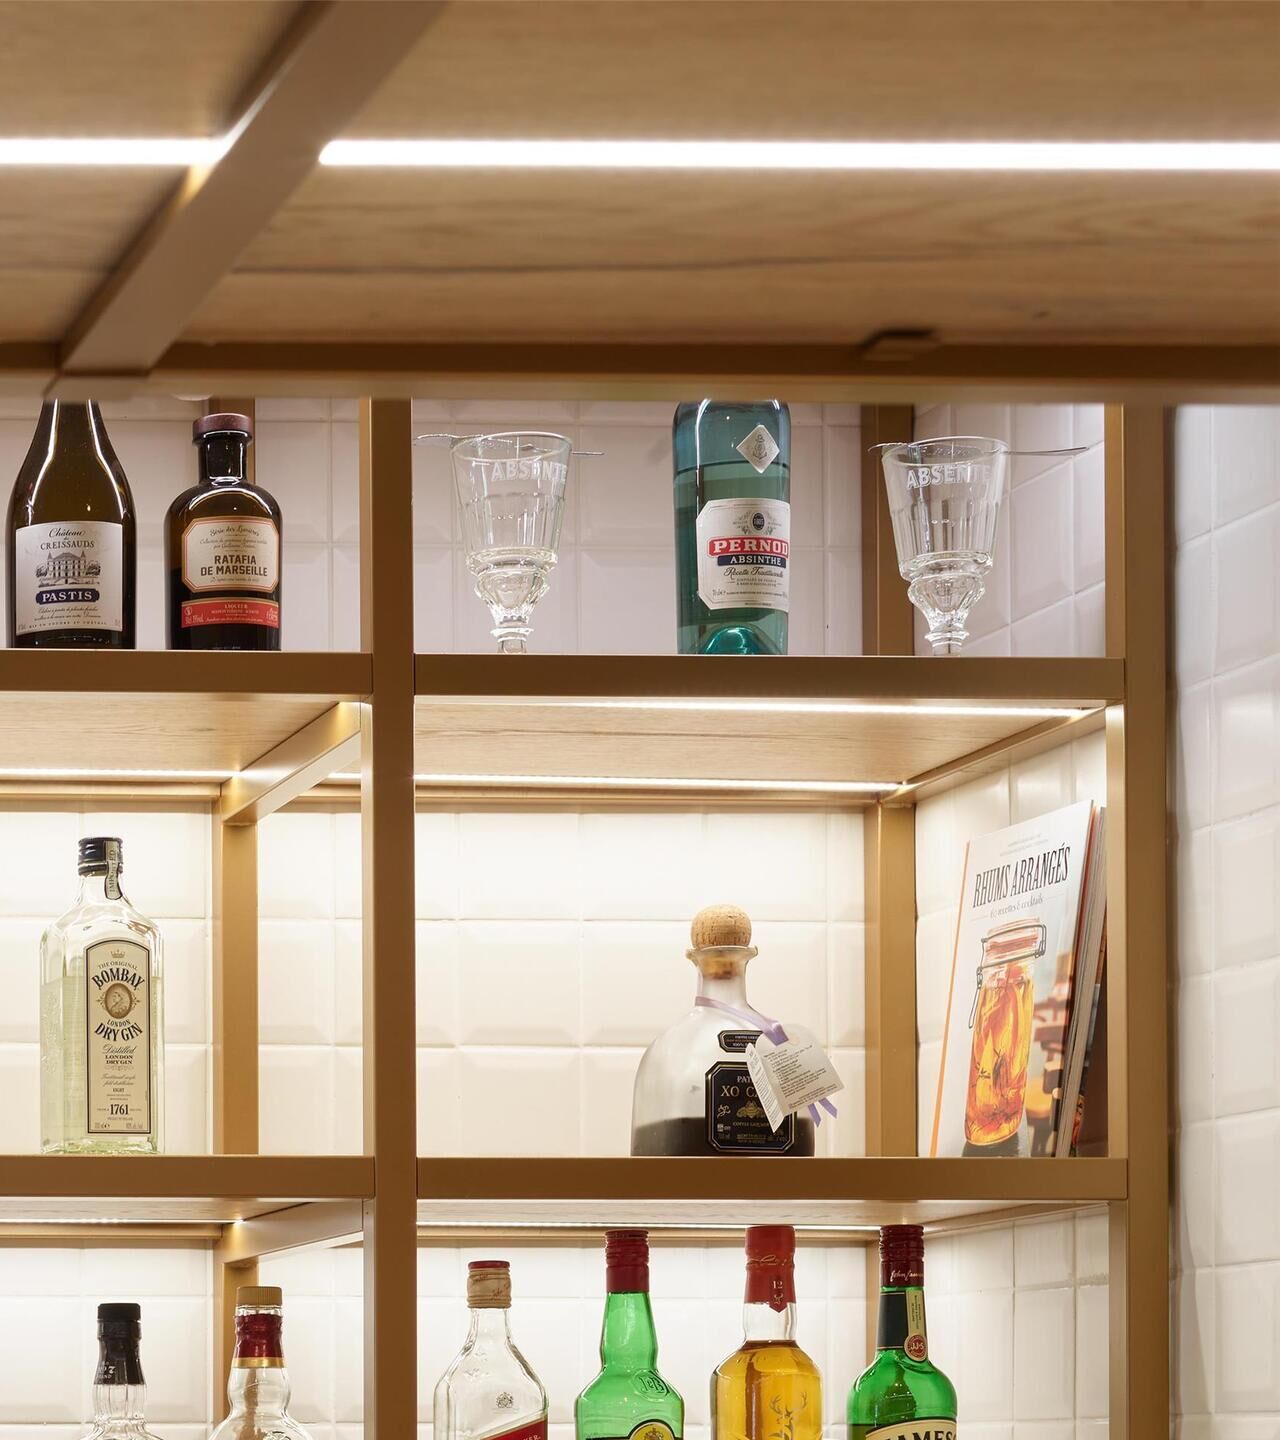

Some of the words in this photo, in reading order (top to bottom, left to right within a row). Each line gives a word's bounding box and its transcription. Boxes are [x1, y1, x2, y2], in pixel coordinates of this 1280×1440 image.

[40, 540, 95, 555] CREISSAUDS
[712, 537, 788, 555] PERNOD
[213, 554, 257, 566] RATAFIA
[729, 553, 782, 567] ABSINTHE
[200, 568, 214, 581] DE
[215, 565, 268, 581] MARSEILLE
[41, 591, 93, 604] PASTIS
[972, 864, 1011, 908] RHUMS
[1010, 842, 1072, 898] ARRANGÉS
[91, 966, 146, 991] BOMBAY
[106, 1018, 132, 1028] LONDON
[94, 1022, 119, 1041] DRY
[121, 1021, 144, 1041] GIN
[719, 1086, 741, 1097] XO
[109, 1103, 130, 1116] 1761
